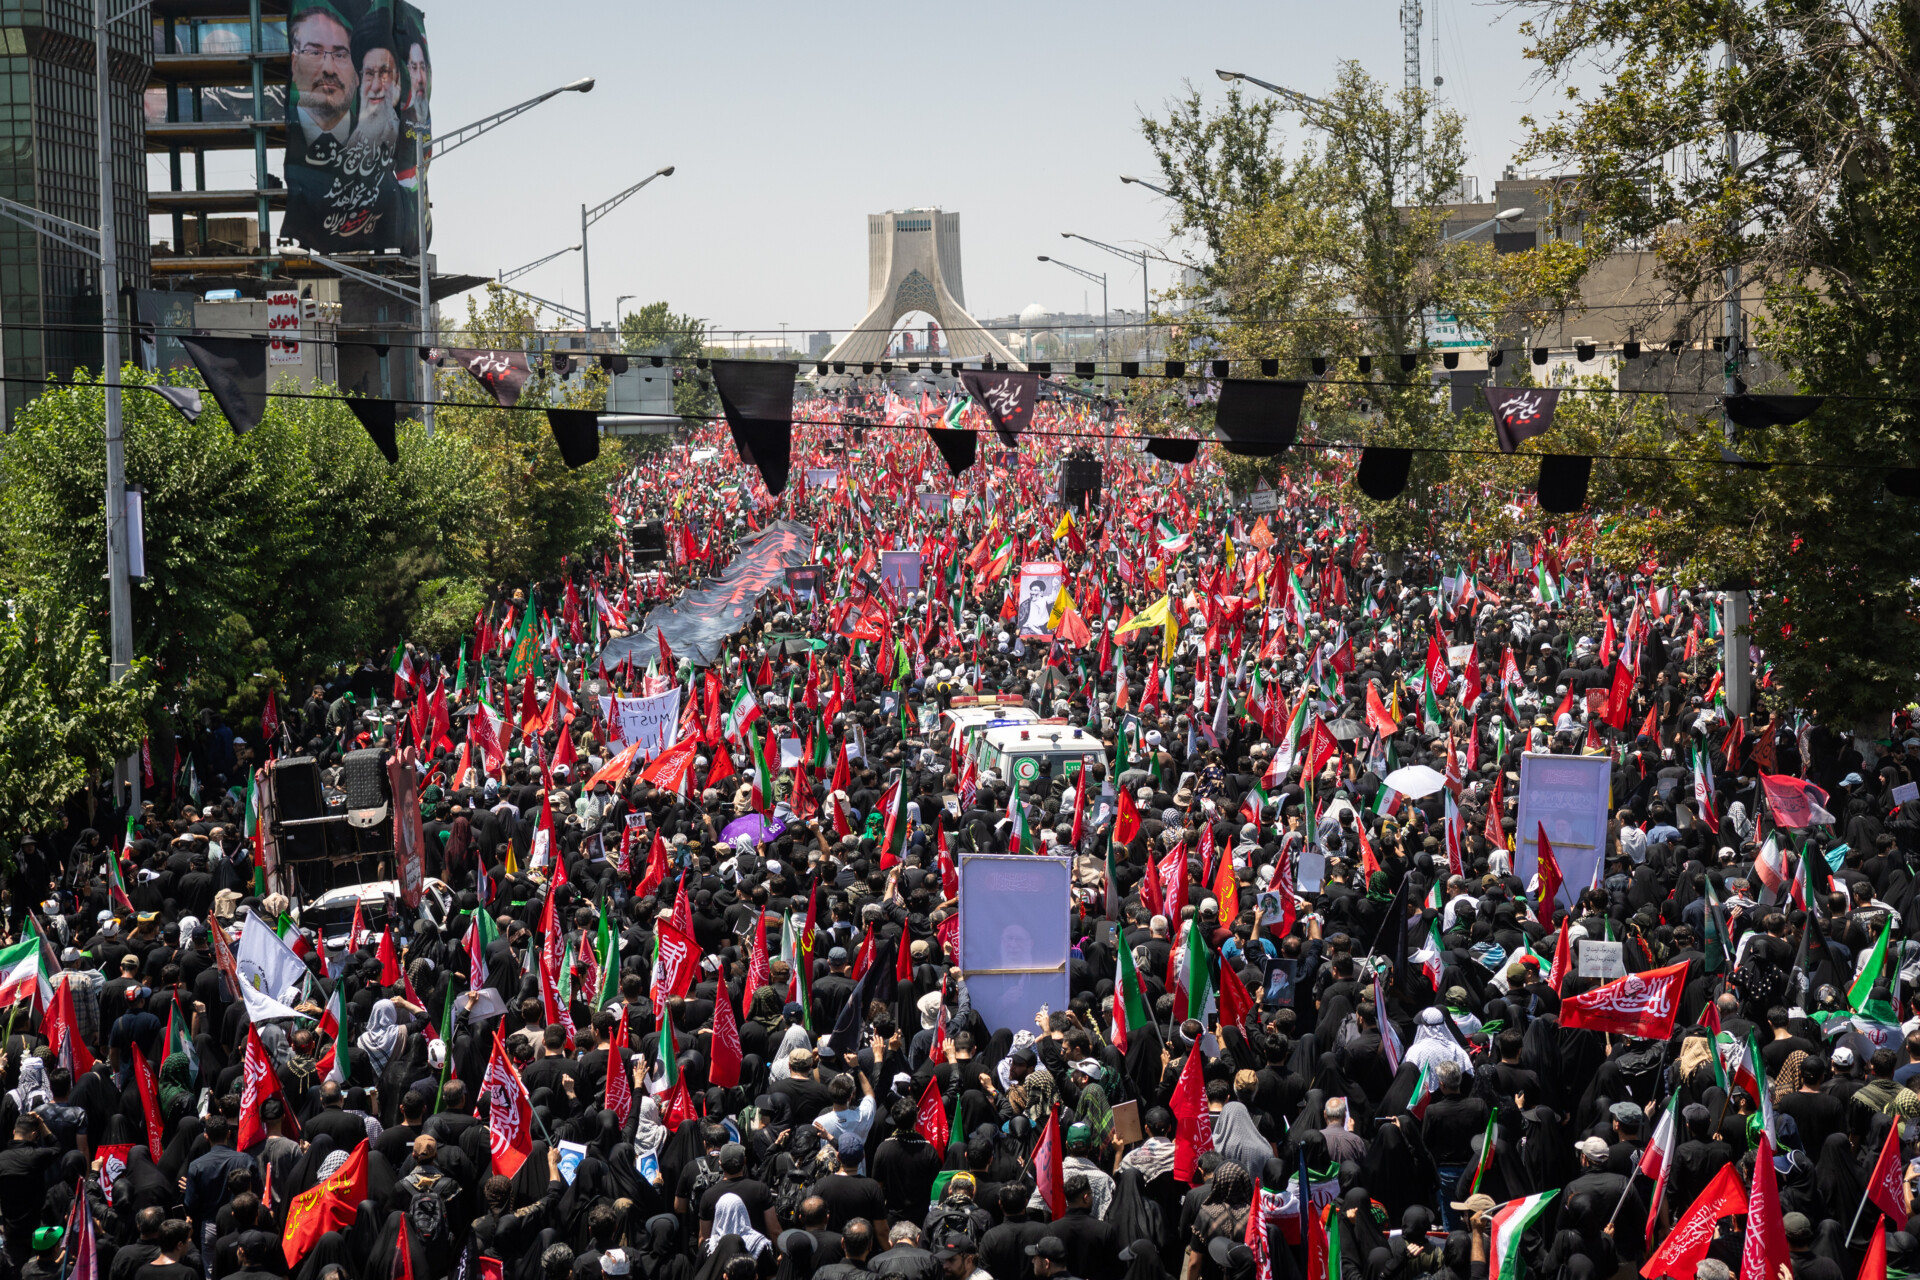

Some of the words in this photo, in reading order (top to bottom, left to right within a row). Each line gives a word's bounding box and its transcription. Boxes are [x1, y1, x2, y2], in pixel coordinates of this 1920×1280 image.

[343, 141, 363, 175] هیچ
[323, 213, 348, 236] ایران
[268, 294, 298, 308] باشگاه
[269, 315, 298, 329] بانوان
